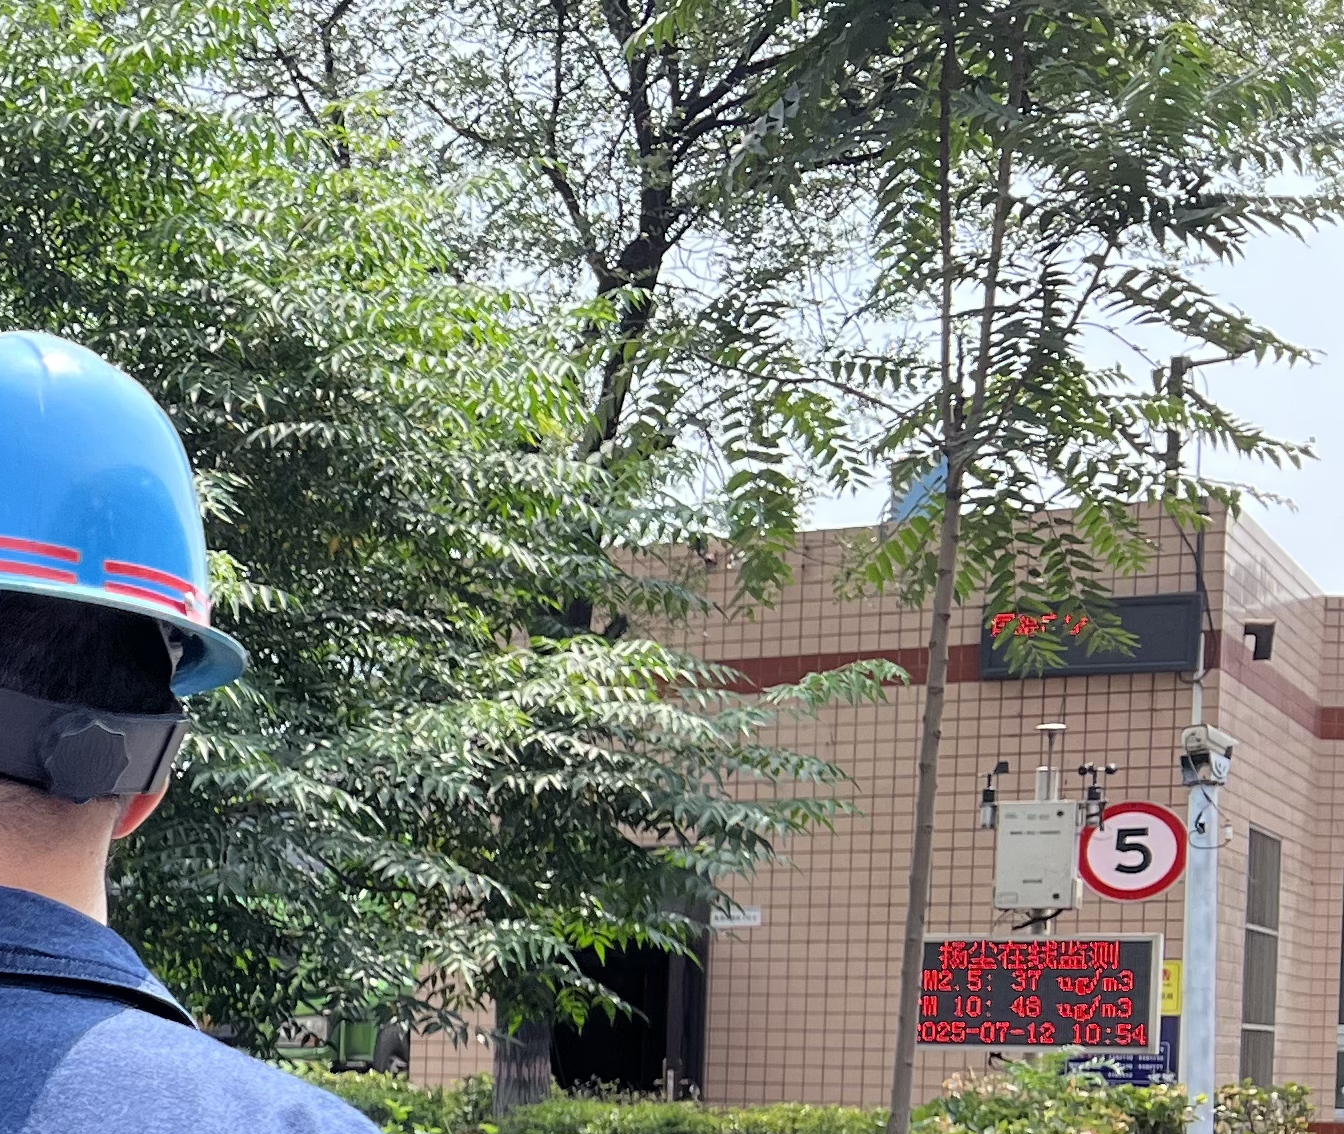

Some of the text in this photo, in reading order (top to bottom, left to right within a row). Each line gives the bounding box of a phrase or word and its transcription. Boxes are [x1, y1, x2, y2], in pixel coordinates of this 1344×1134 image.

[1114, 827, 1153, 875] 5
[939, 940, 1120, 970] 扬尘在线监测
[921, 968, 1134, 995] M2.5: 37 ug/m3
[918, 995, 1132, 1021] M 10: 48 ug/m3
[1072, 1023, 1147, 1046] 10:54
